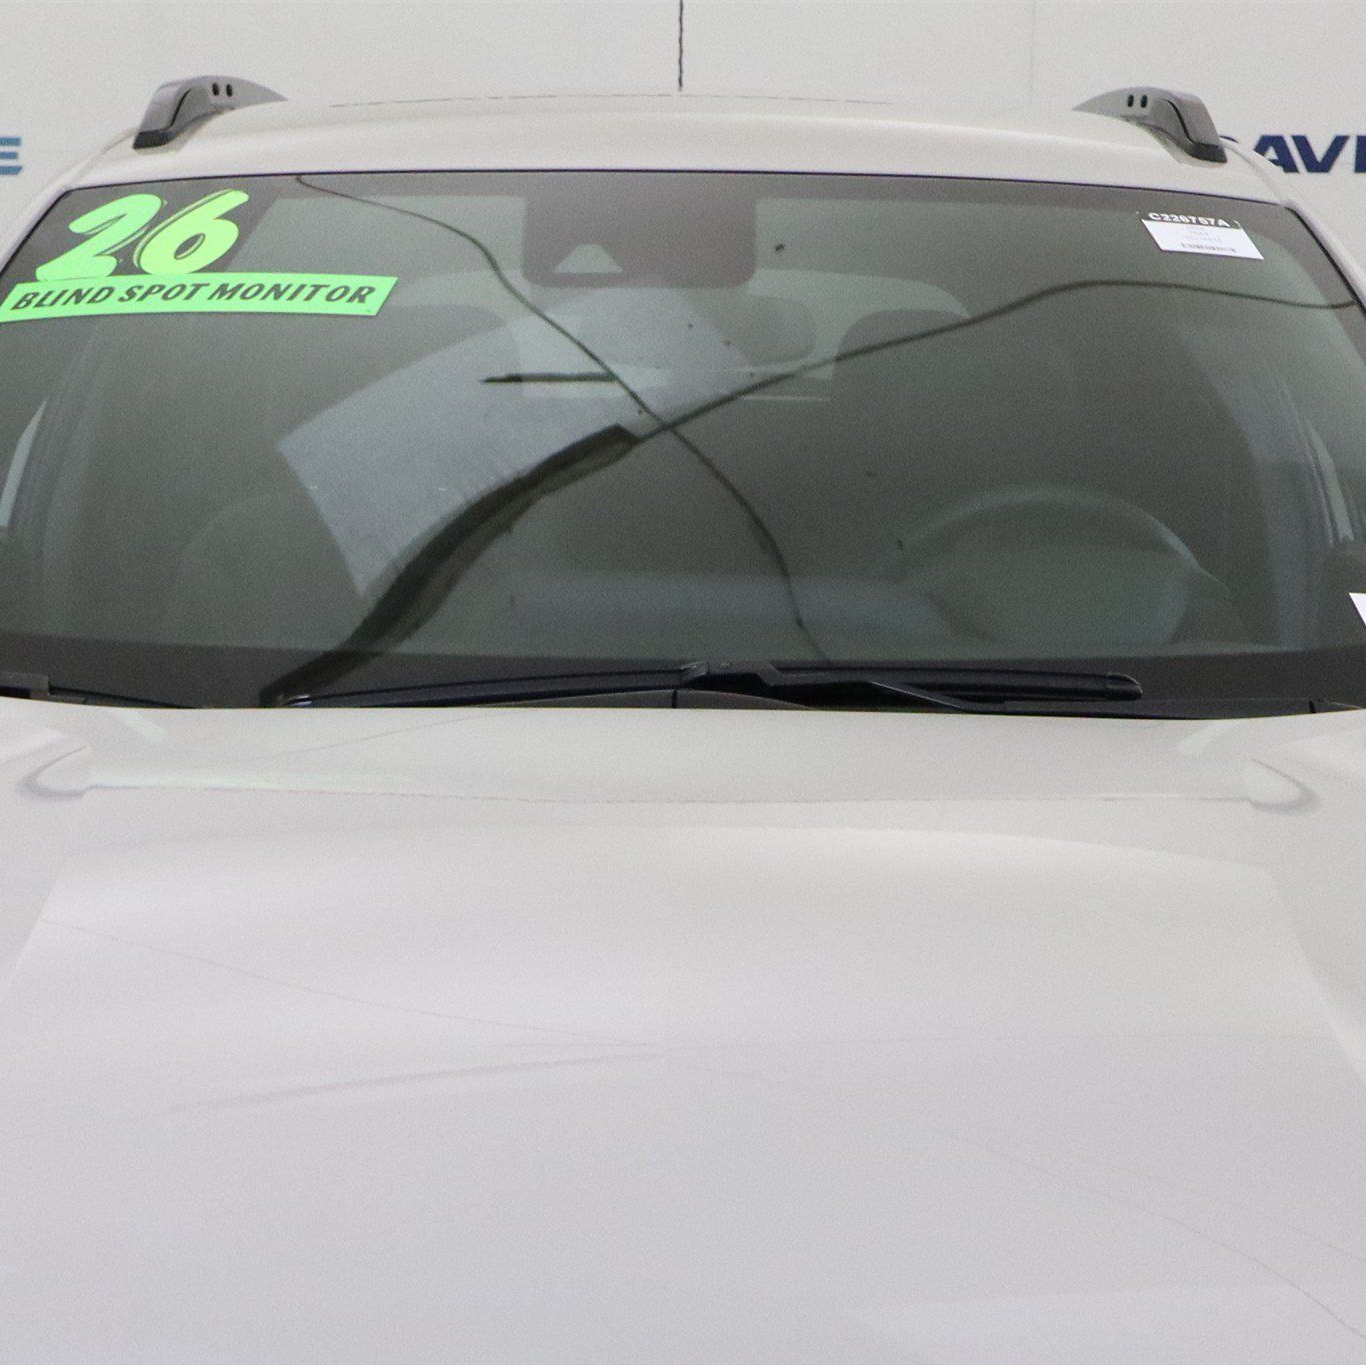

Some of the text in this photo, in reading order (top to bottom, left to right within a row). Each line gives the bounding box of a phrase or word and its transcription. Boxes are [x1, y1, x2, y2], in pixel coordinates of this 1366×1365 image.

[35, 188, 250, 282] 26
[10, 282, 378, 312] BLIND SPOT MONITOR
